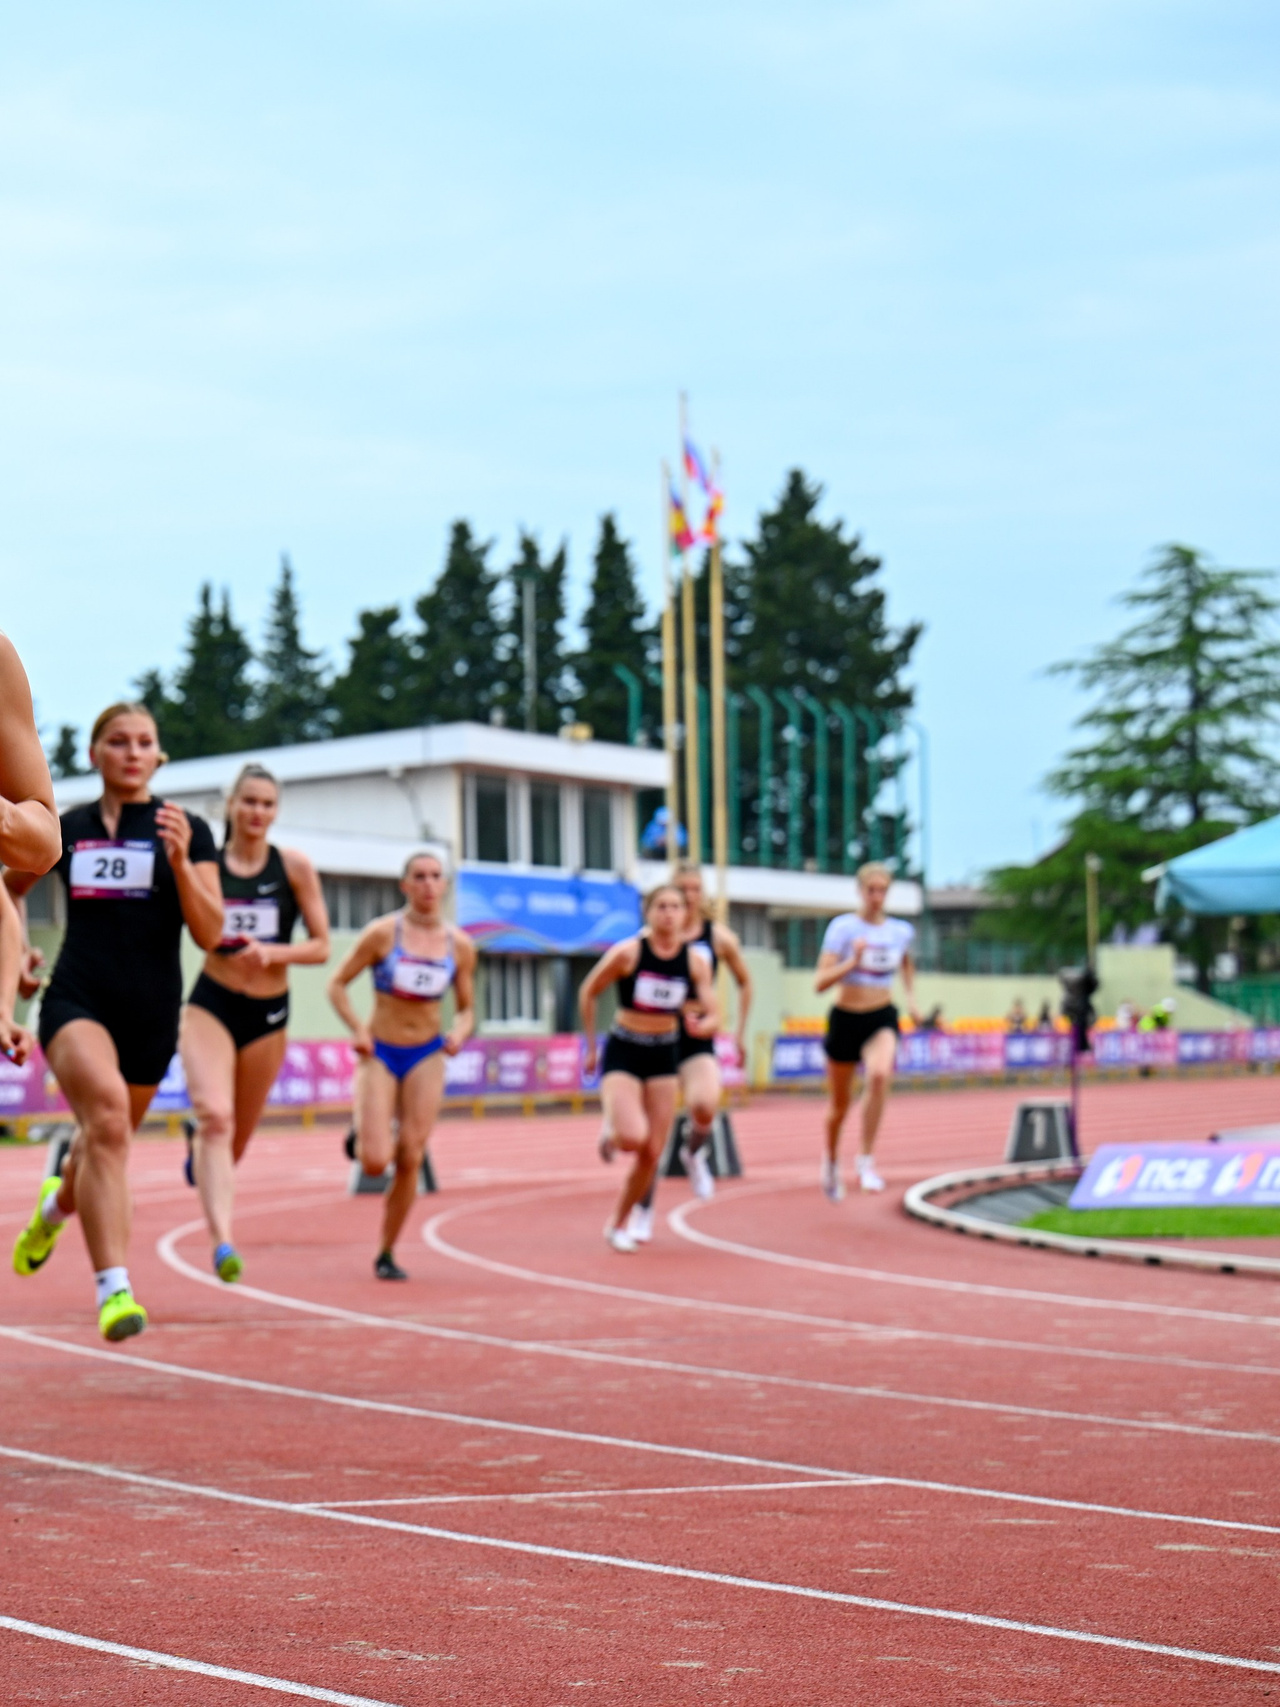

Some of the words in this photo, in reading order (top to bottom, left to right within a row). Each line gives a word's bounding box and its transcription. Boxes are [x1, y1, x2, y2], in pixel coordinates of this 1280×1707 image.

[94, 857, 126, 879] 28
[1029, 1110, 1046, 1149] 1
[1136, 1157, 1212, 1191] ПСБ
